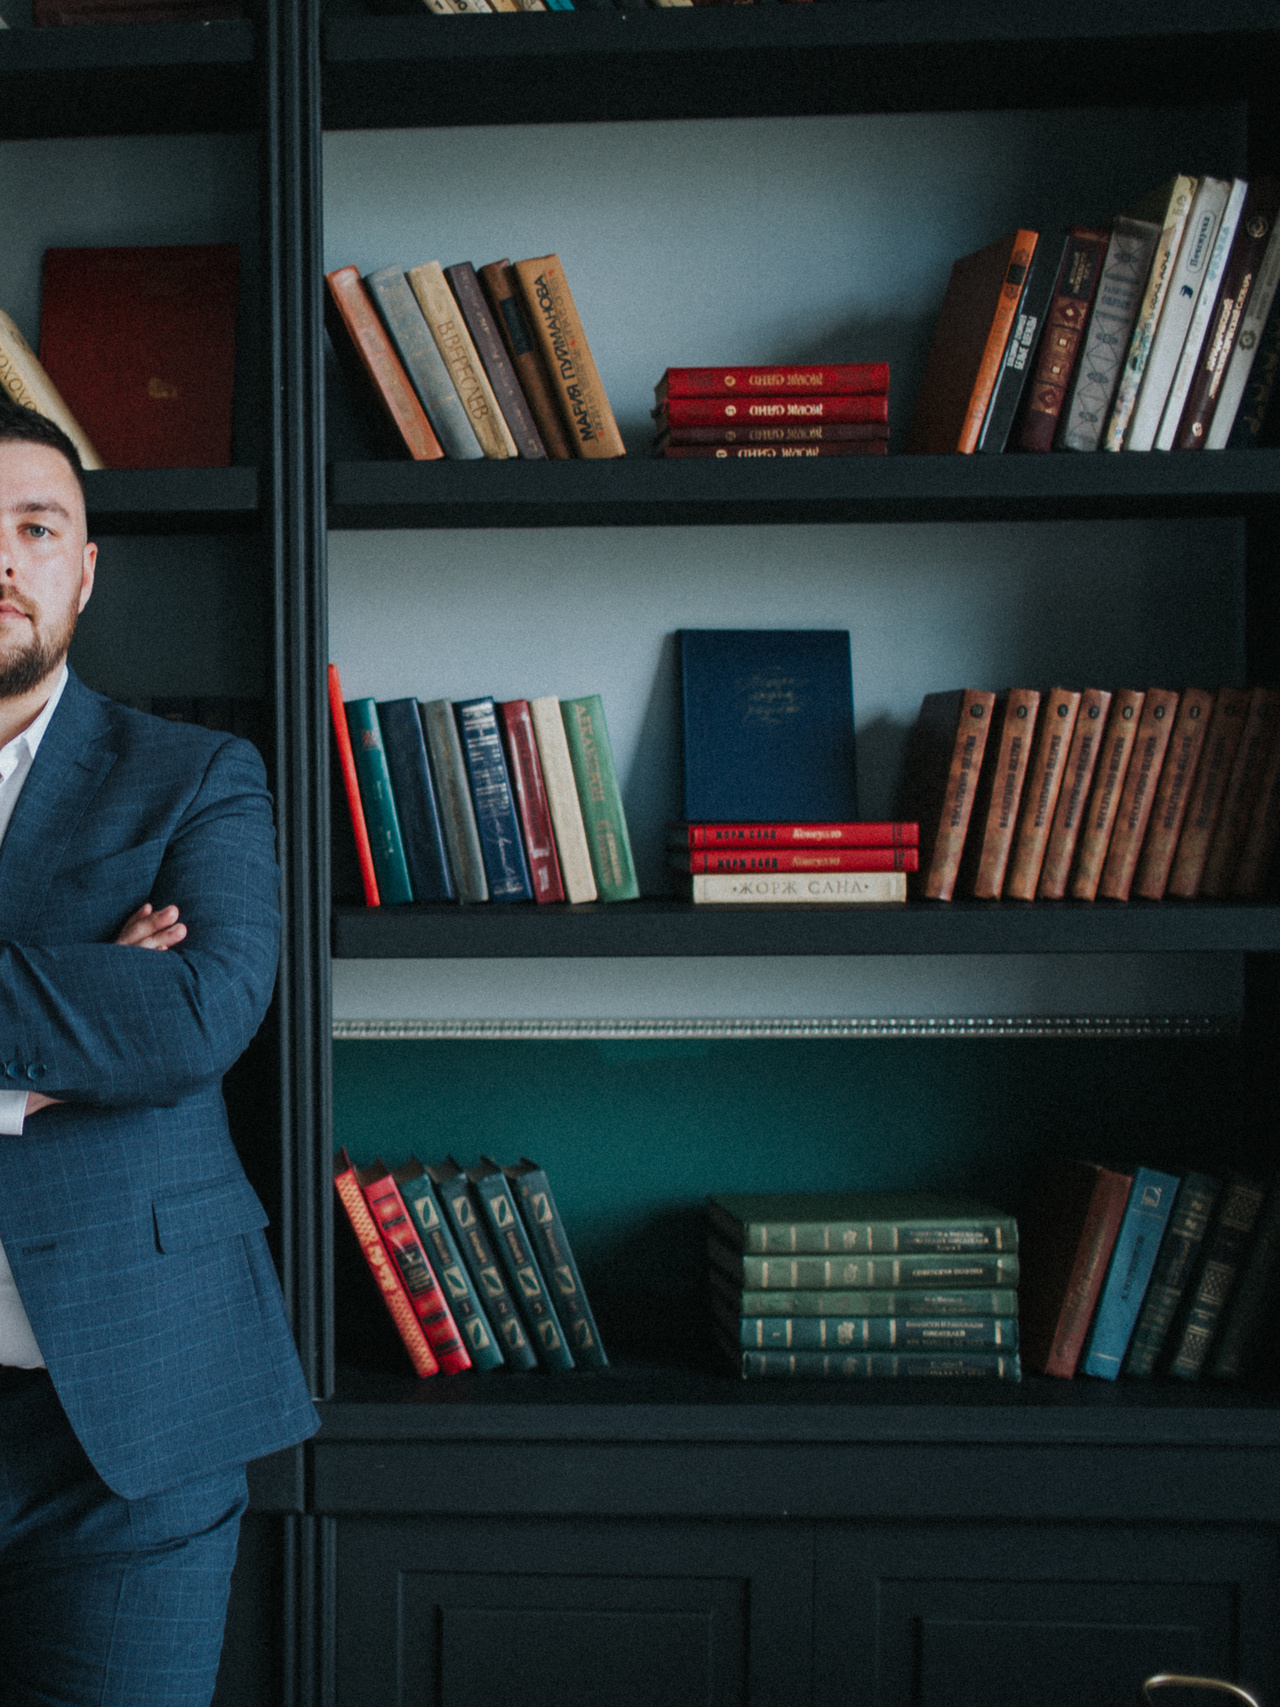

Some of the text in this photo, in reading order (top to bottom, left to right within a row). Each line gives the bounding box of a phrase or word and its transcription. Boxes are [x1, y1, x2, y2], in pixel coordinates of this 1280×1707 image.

[534, 273, 575, 380] ПУЙМАНОВА
[566, 383, 594, 441] МАРИЯ
[572, 700, 605, 805] ДЕКАМЕРОН
[715, 829, 744, 840] ЖОРЖ
[749, 829, 776, 840] САНД
[717, 858, 745, 868] ЖОРЖ
[750, 857, 777, 868] САНД
[738, 880, 797, 895] ЖОРЖ
